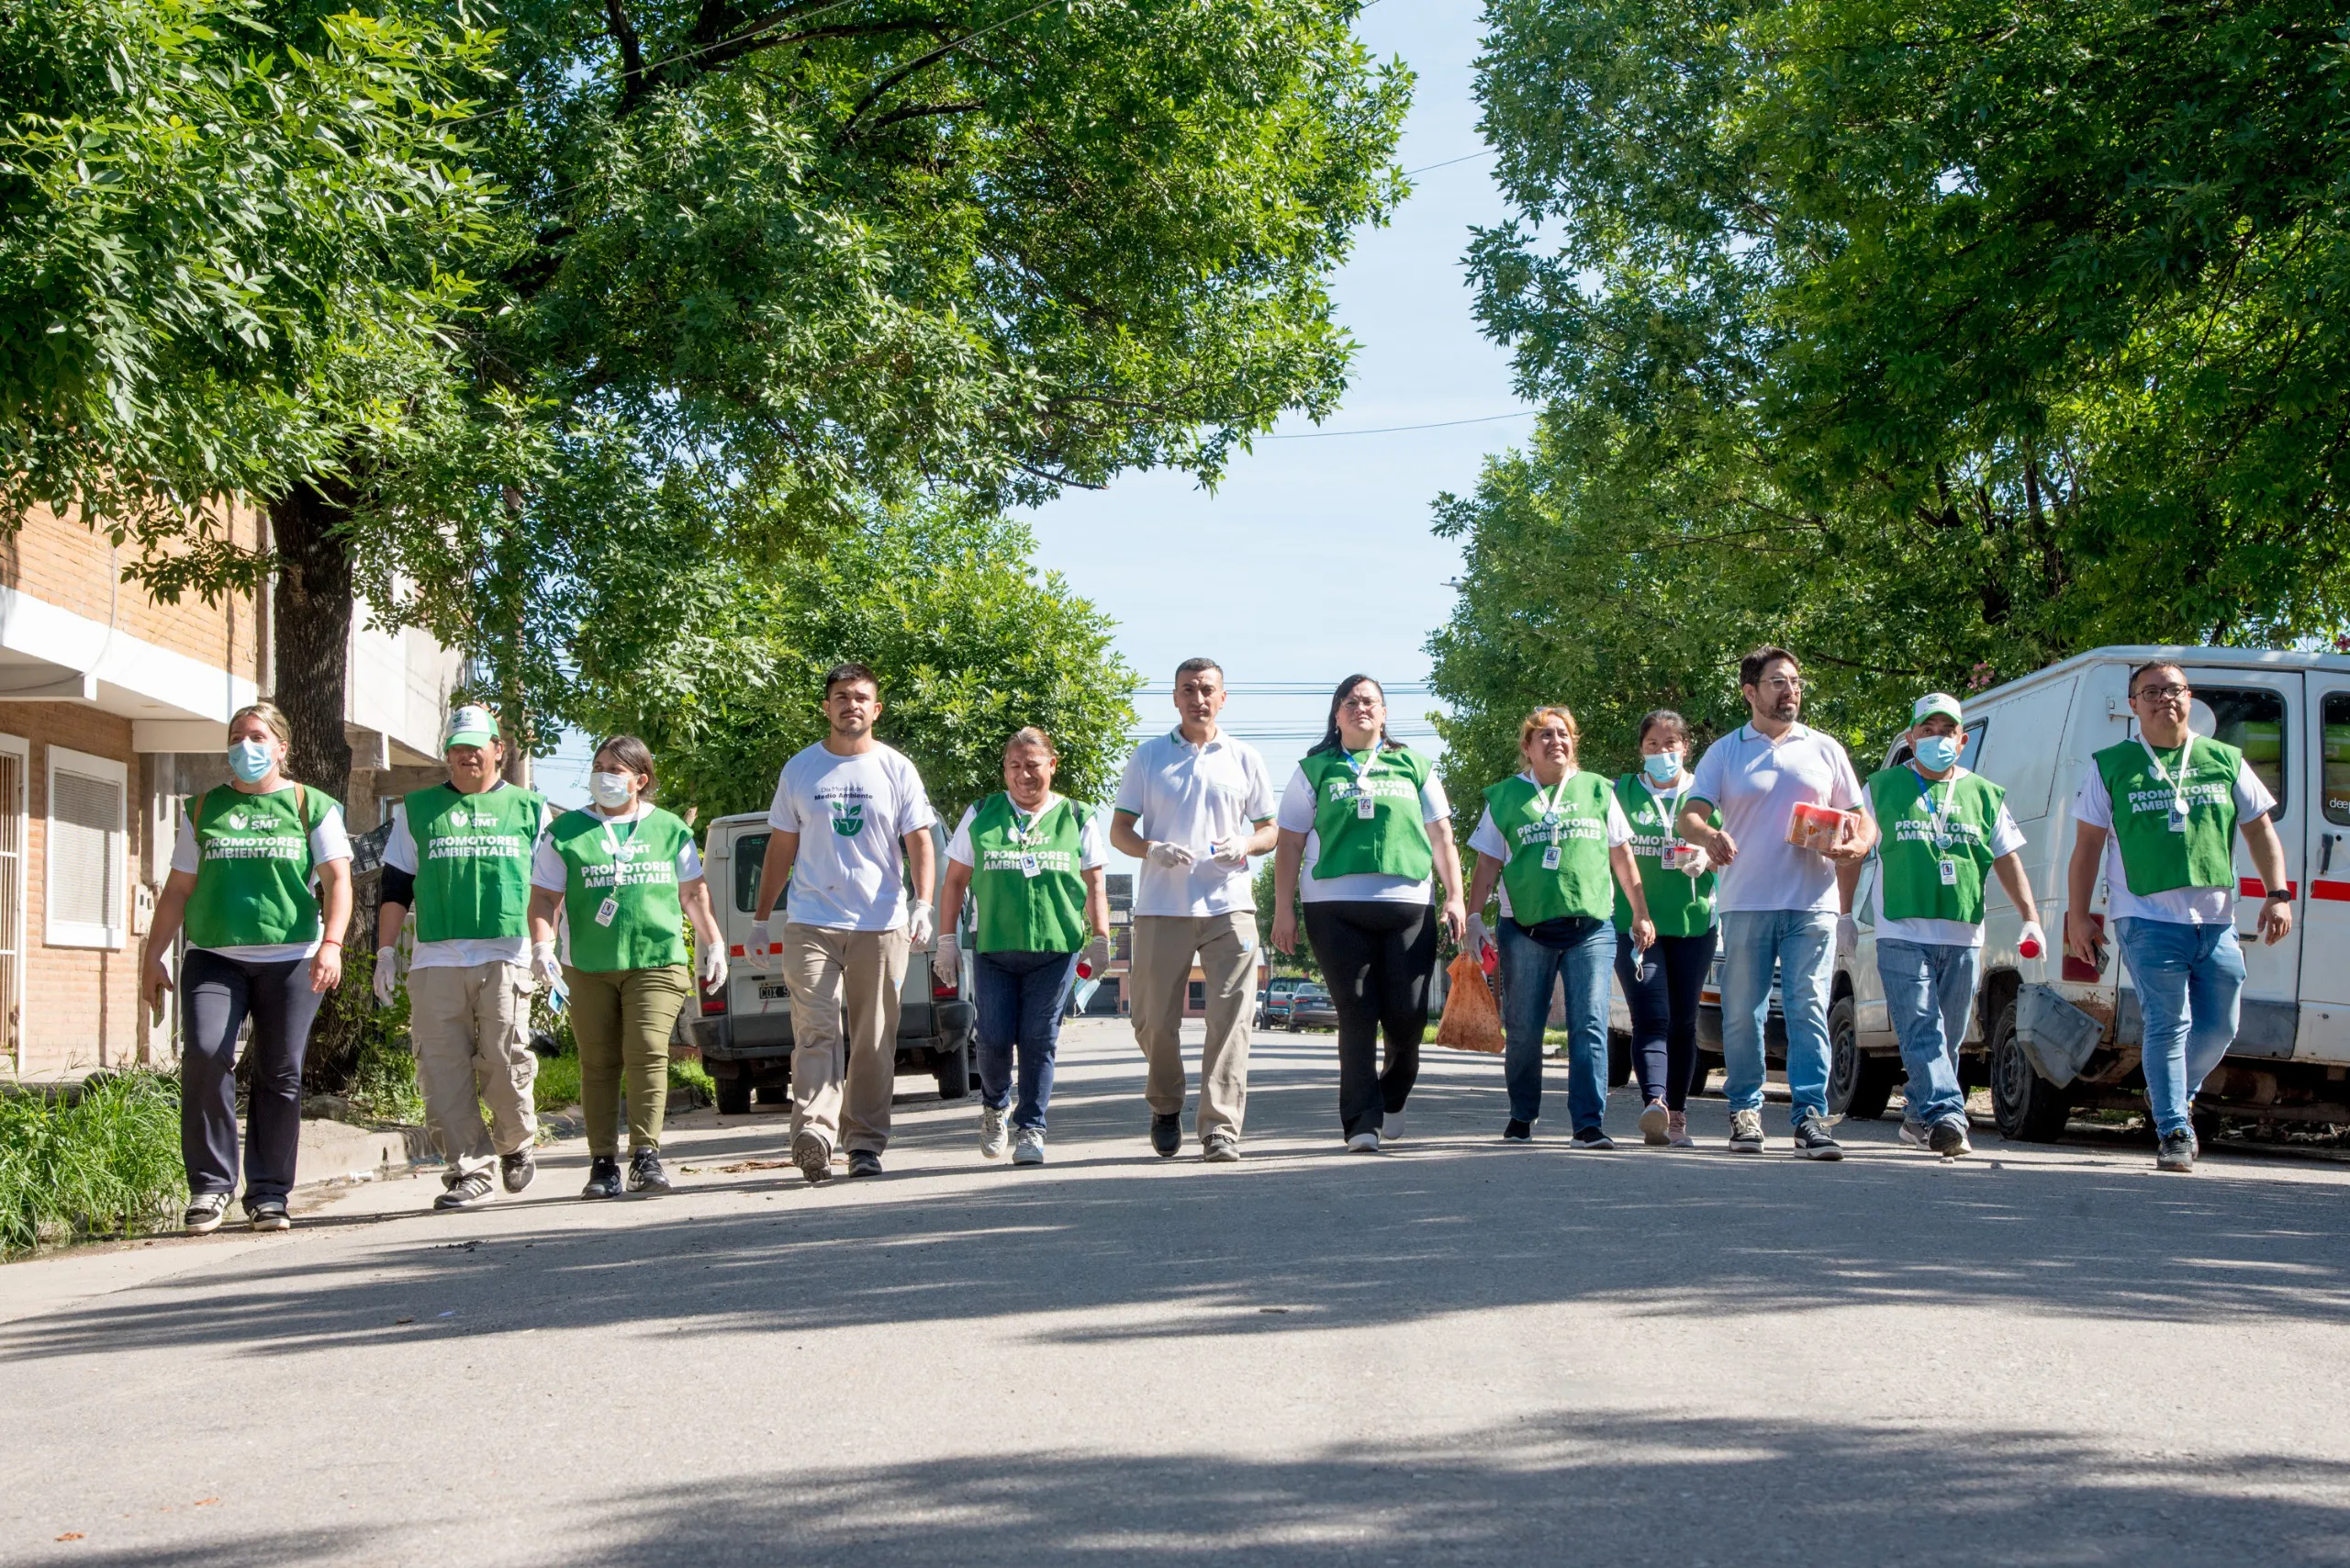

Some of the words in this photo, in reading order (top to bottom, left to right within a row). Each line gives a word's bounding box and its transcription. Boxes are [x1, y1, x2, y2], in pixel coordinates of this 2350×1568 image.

[1329, 779, 1415, 793] PROOTORES
[2132, 794, 2229, 813] AMBIETALES
[2329, 797, 2350, 814] dee
[251, 818, 282, 831] SMT
[471, 818, 499, 829] SMT
[1895, 819, 1981, 836] PROMTORES
[205, 836, 302, 849] PROMOTORES
[429, 835, 520, 849] PROMOTORES
[1521, 828, 1602, 846] AMBINTALES
[1897, 830, 1981, 846] AMBIEALES
[205, 847, 301, 861] AMBIENTALES
[428, 846, 520, 860] AMBIENTALES
[627, 844, 652, 855] MT
[983, 849, 1071, 862] PROMTORES
[983, 860, 1070, 872] AMBIEALES
[760, 986, 778, 998] COX
